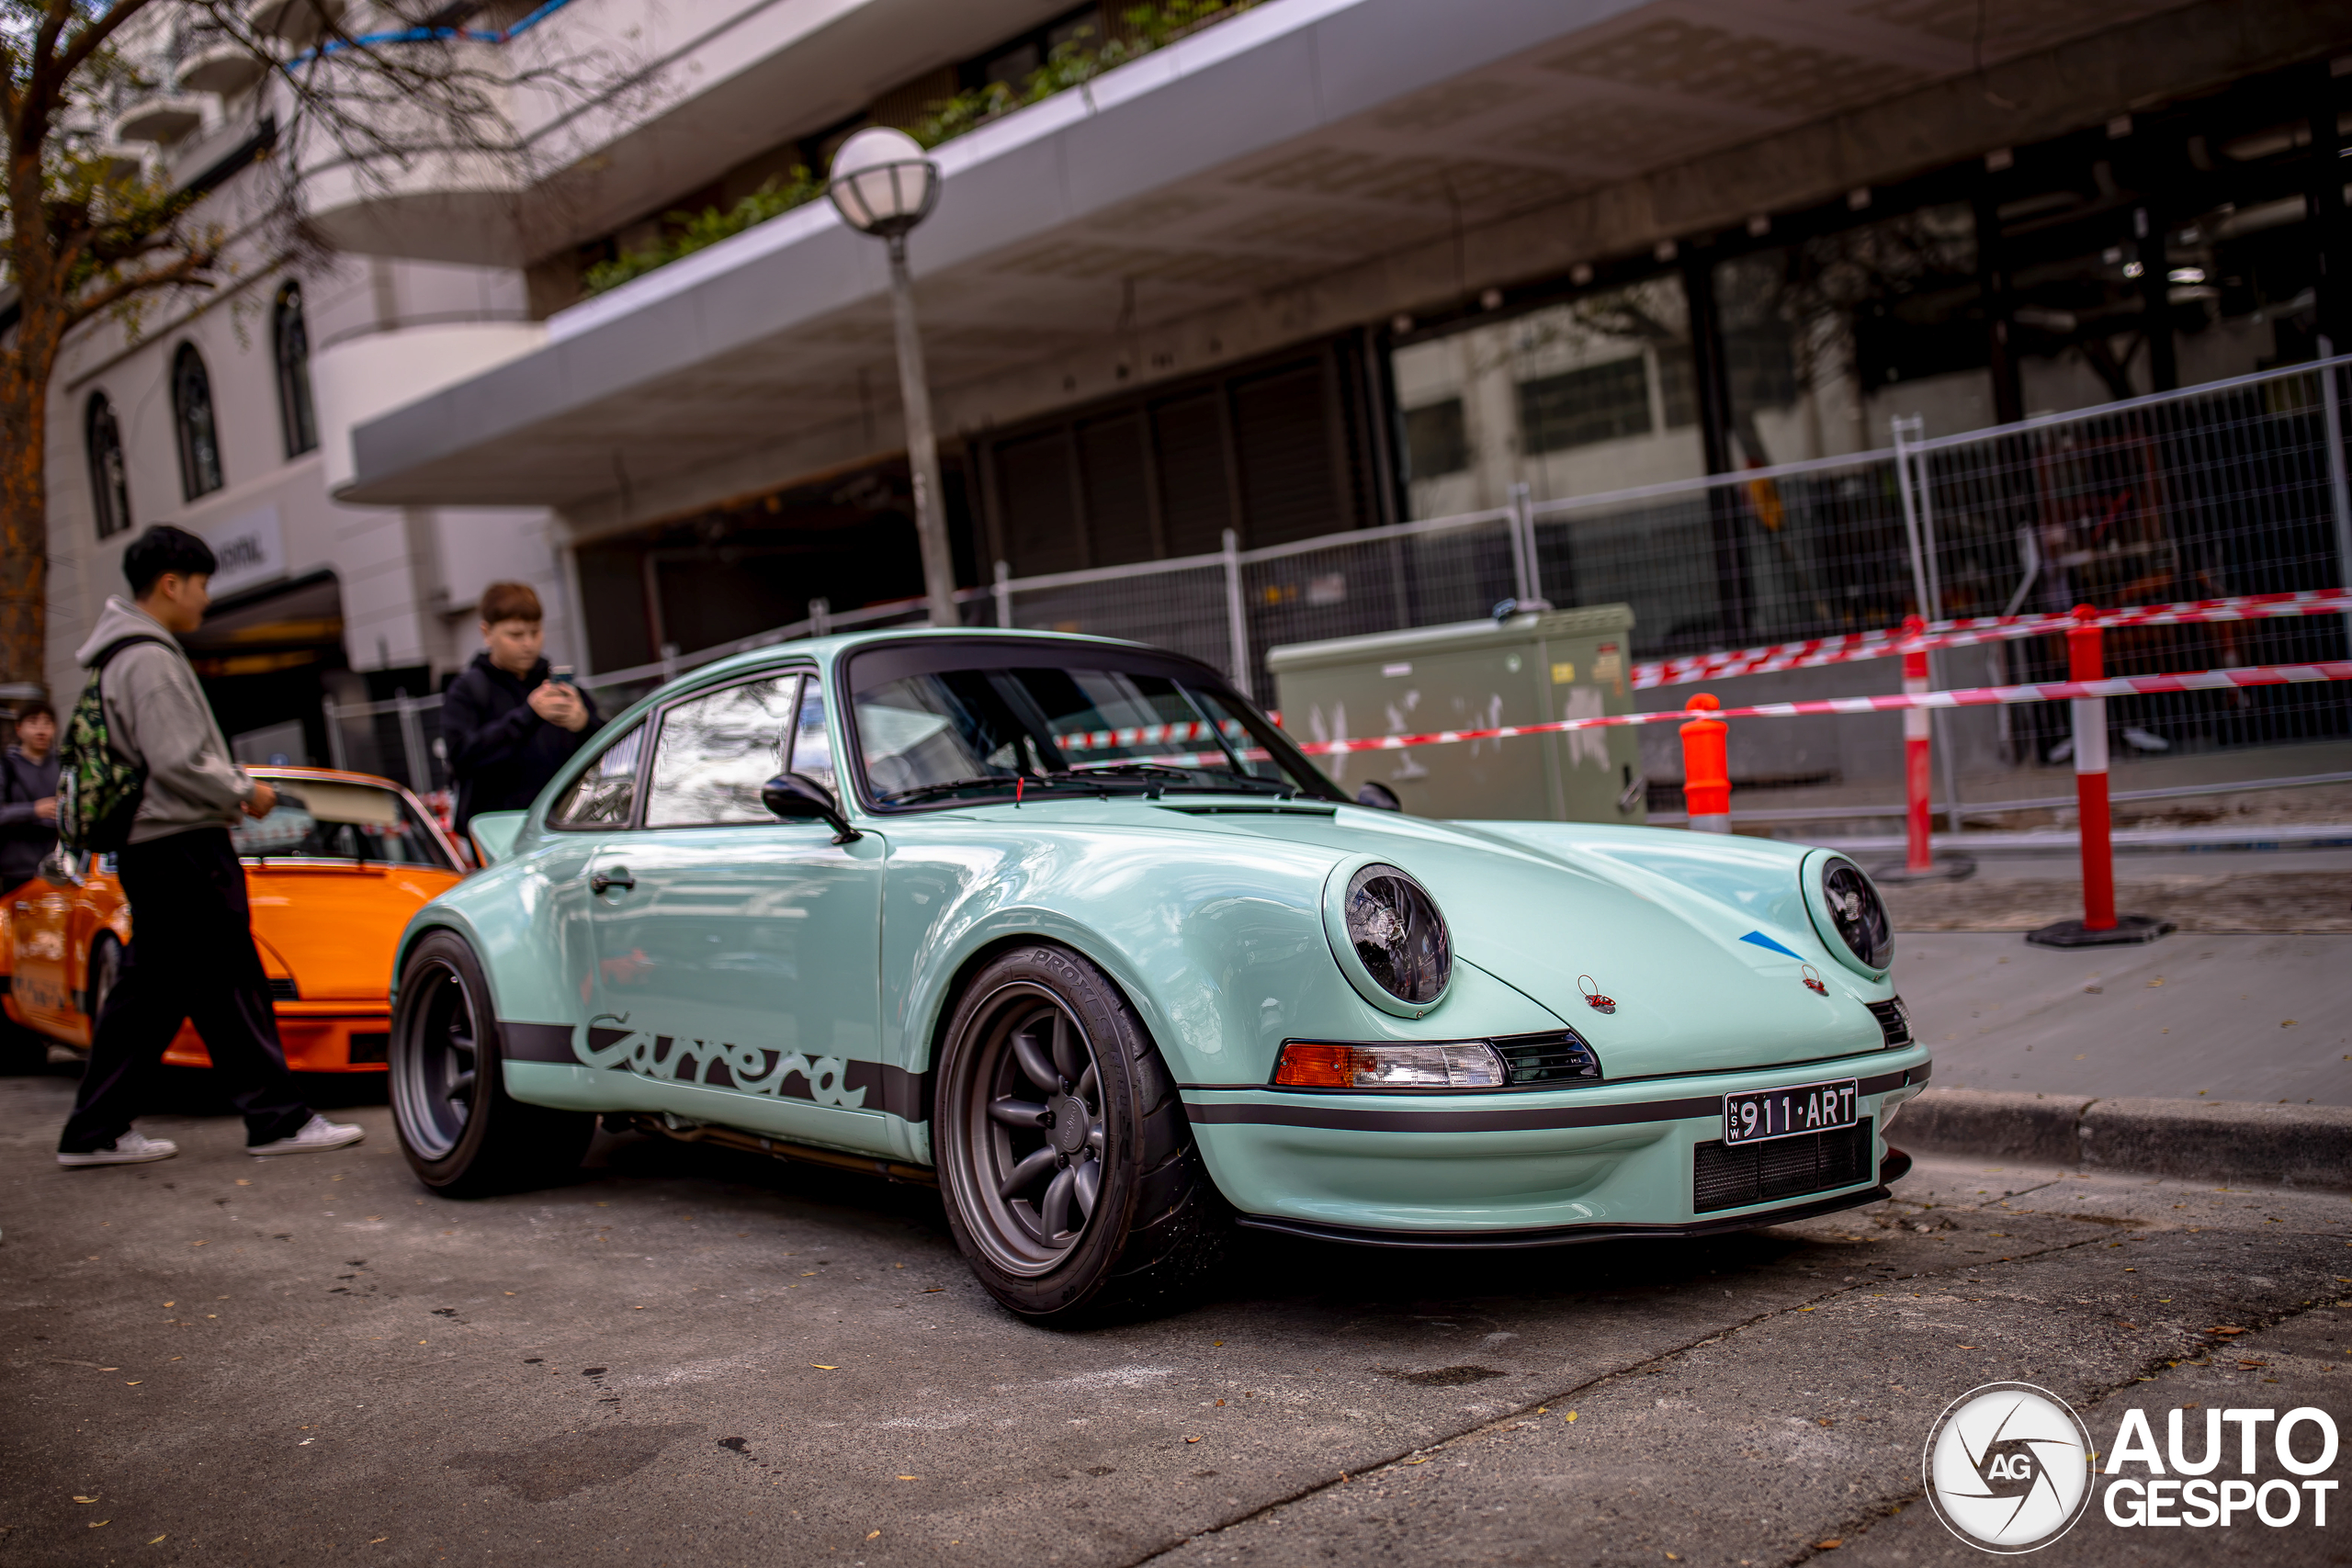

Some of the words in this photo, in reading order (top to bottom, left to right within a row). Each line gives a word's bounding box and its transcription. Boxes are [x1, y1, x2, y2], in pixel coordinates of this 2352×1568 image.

[1031, 950, 1114, 1040] PROXES
[570, 1010, 867, 1109] Carrera
[1729, 1101, 1740, 1140] NSW
